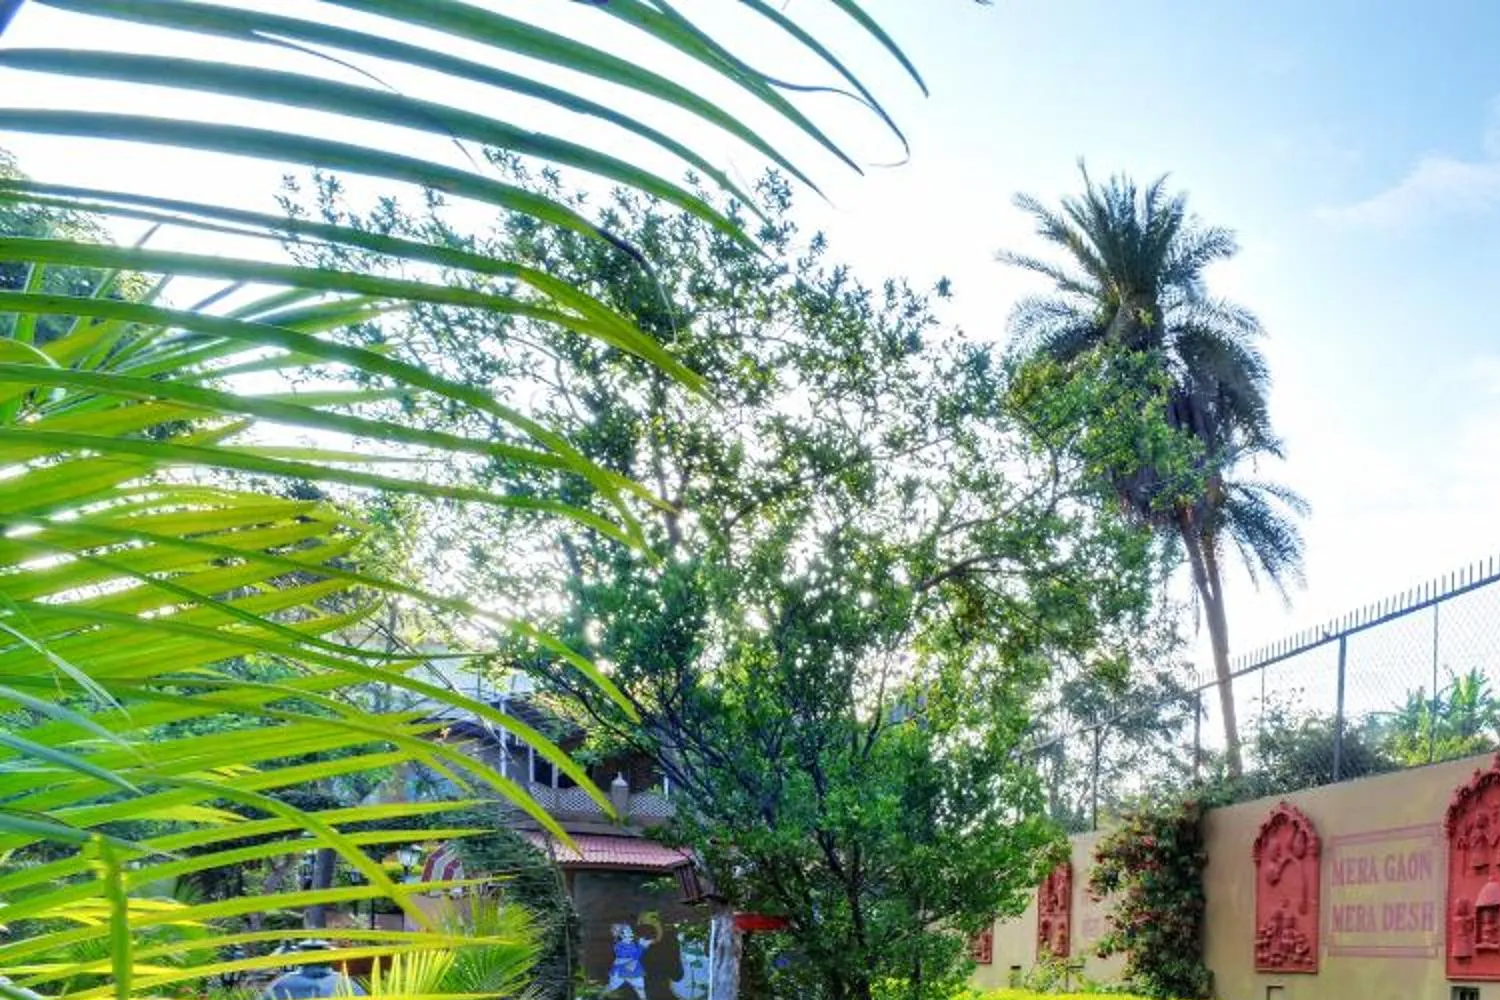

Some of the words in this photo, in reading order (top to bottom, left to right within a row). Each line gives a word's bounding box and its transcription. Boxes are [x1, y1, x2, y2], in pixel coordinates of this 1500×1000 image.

[1332, 855, 1378, 886] MERA
[1384, 849, 1432, 882] GAON
[1332, 904, 1377, 932] MERA
[1382, 901, 1434, 931] DESH
